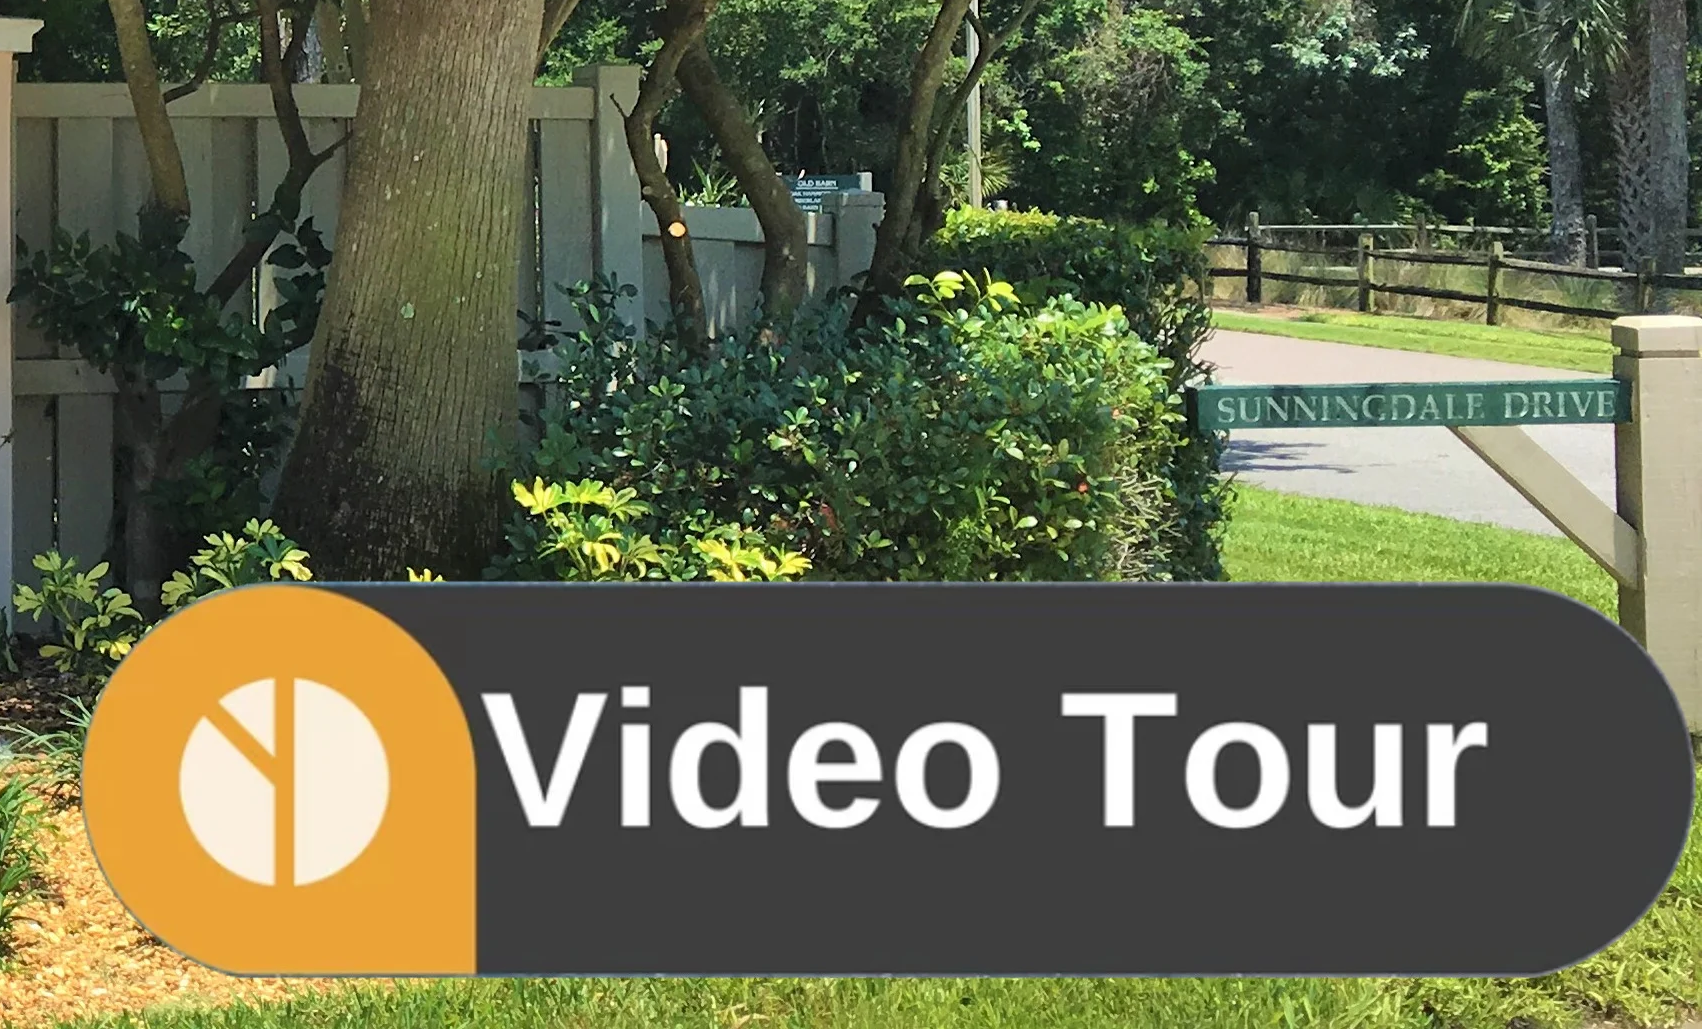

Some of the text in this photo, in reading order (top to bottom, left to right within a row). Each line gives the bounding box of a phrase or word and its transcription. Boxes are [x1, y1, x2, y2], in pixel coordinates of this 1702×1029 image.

[797, 179, 815, 187] OLD
[1216, 389, 1617, 424] SUNNINGDALE DRIVE
